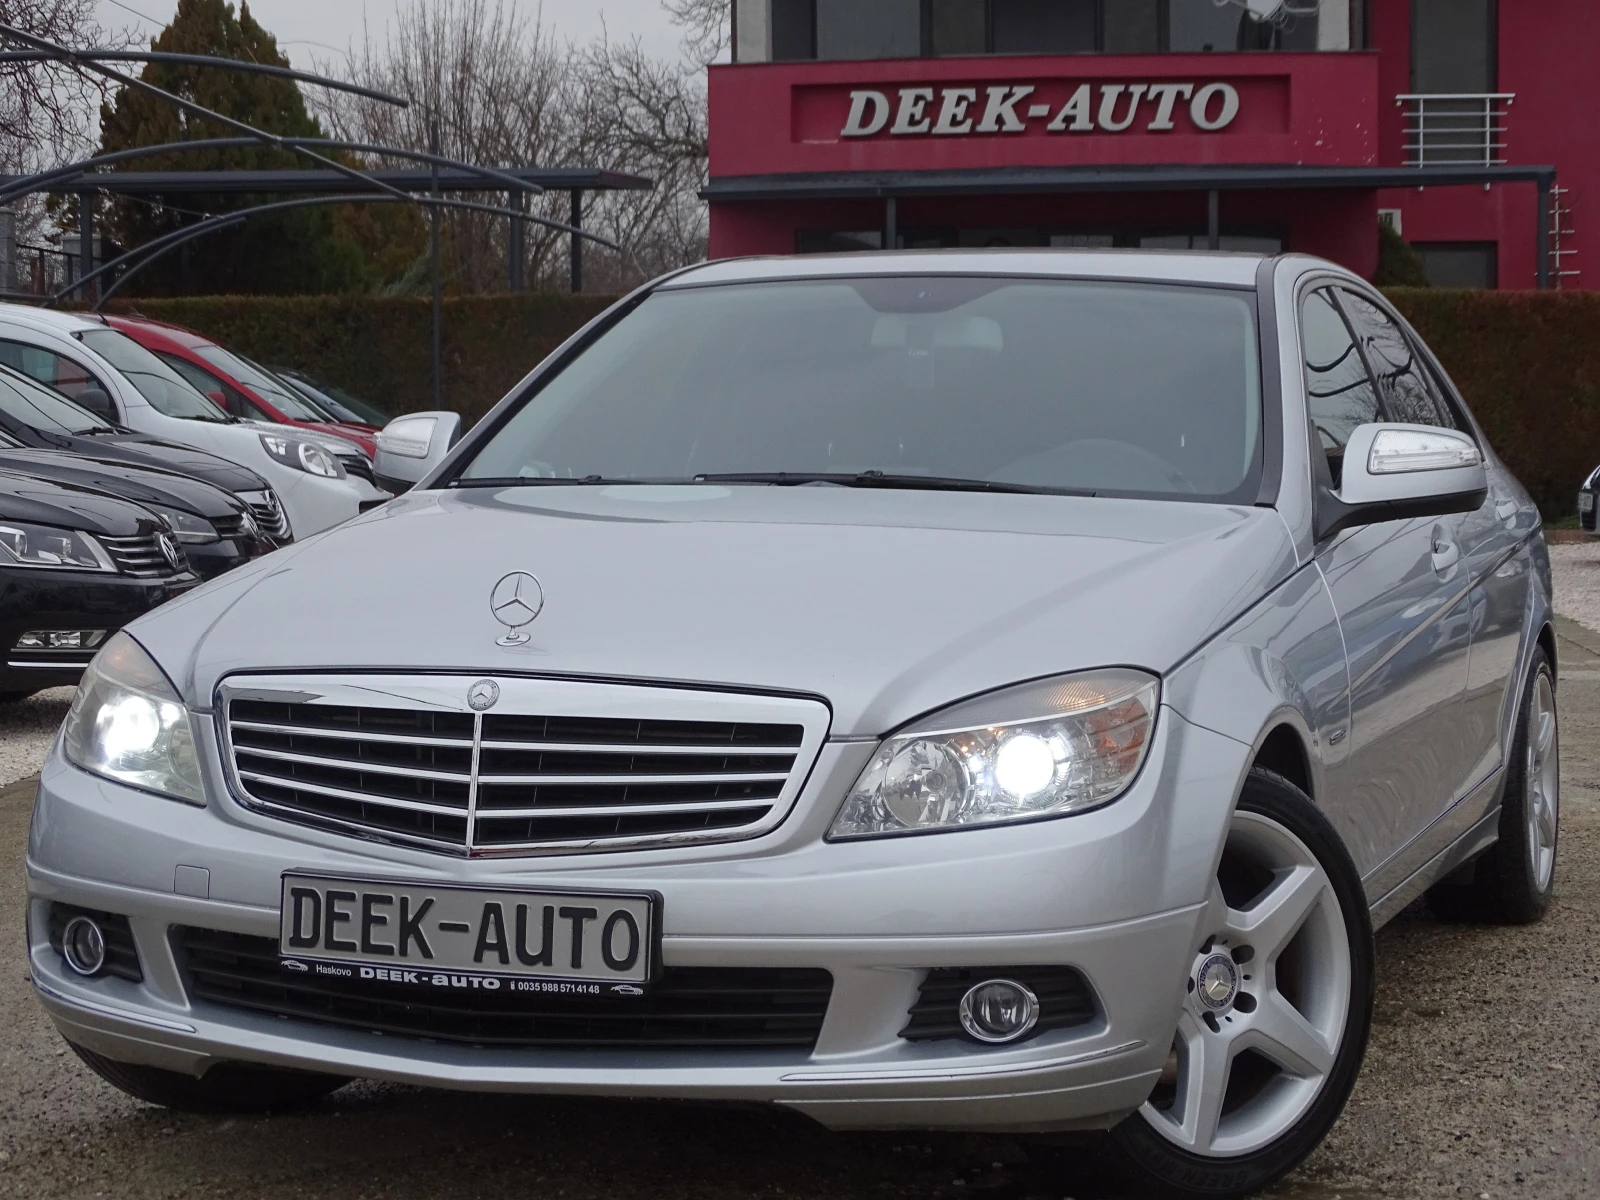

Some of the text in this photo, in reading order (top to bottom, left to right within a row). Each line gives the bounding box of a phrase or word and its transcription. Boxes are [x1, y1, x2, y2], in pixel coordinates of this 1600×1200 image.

[840, 83, 1239, 136] DEEK-AUTO
[288, 886, 640, 971] DEEK-AUTO
[316, 964, 352, 977] Haskovo
[518, 981, 541, 991] 0035
[542, 982, 559, 992] 988
[560, 984, 575, 993] 571
[577, 984, 587, 993] 41
[588, 985, 600, 994] 48
